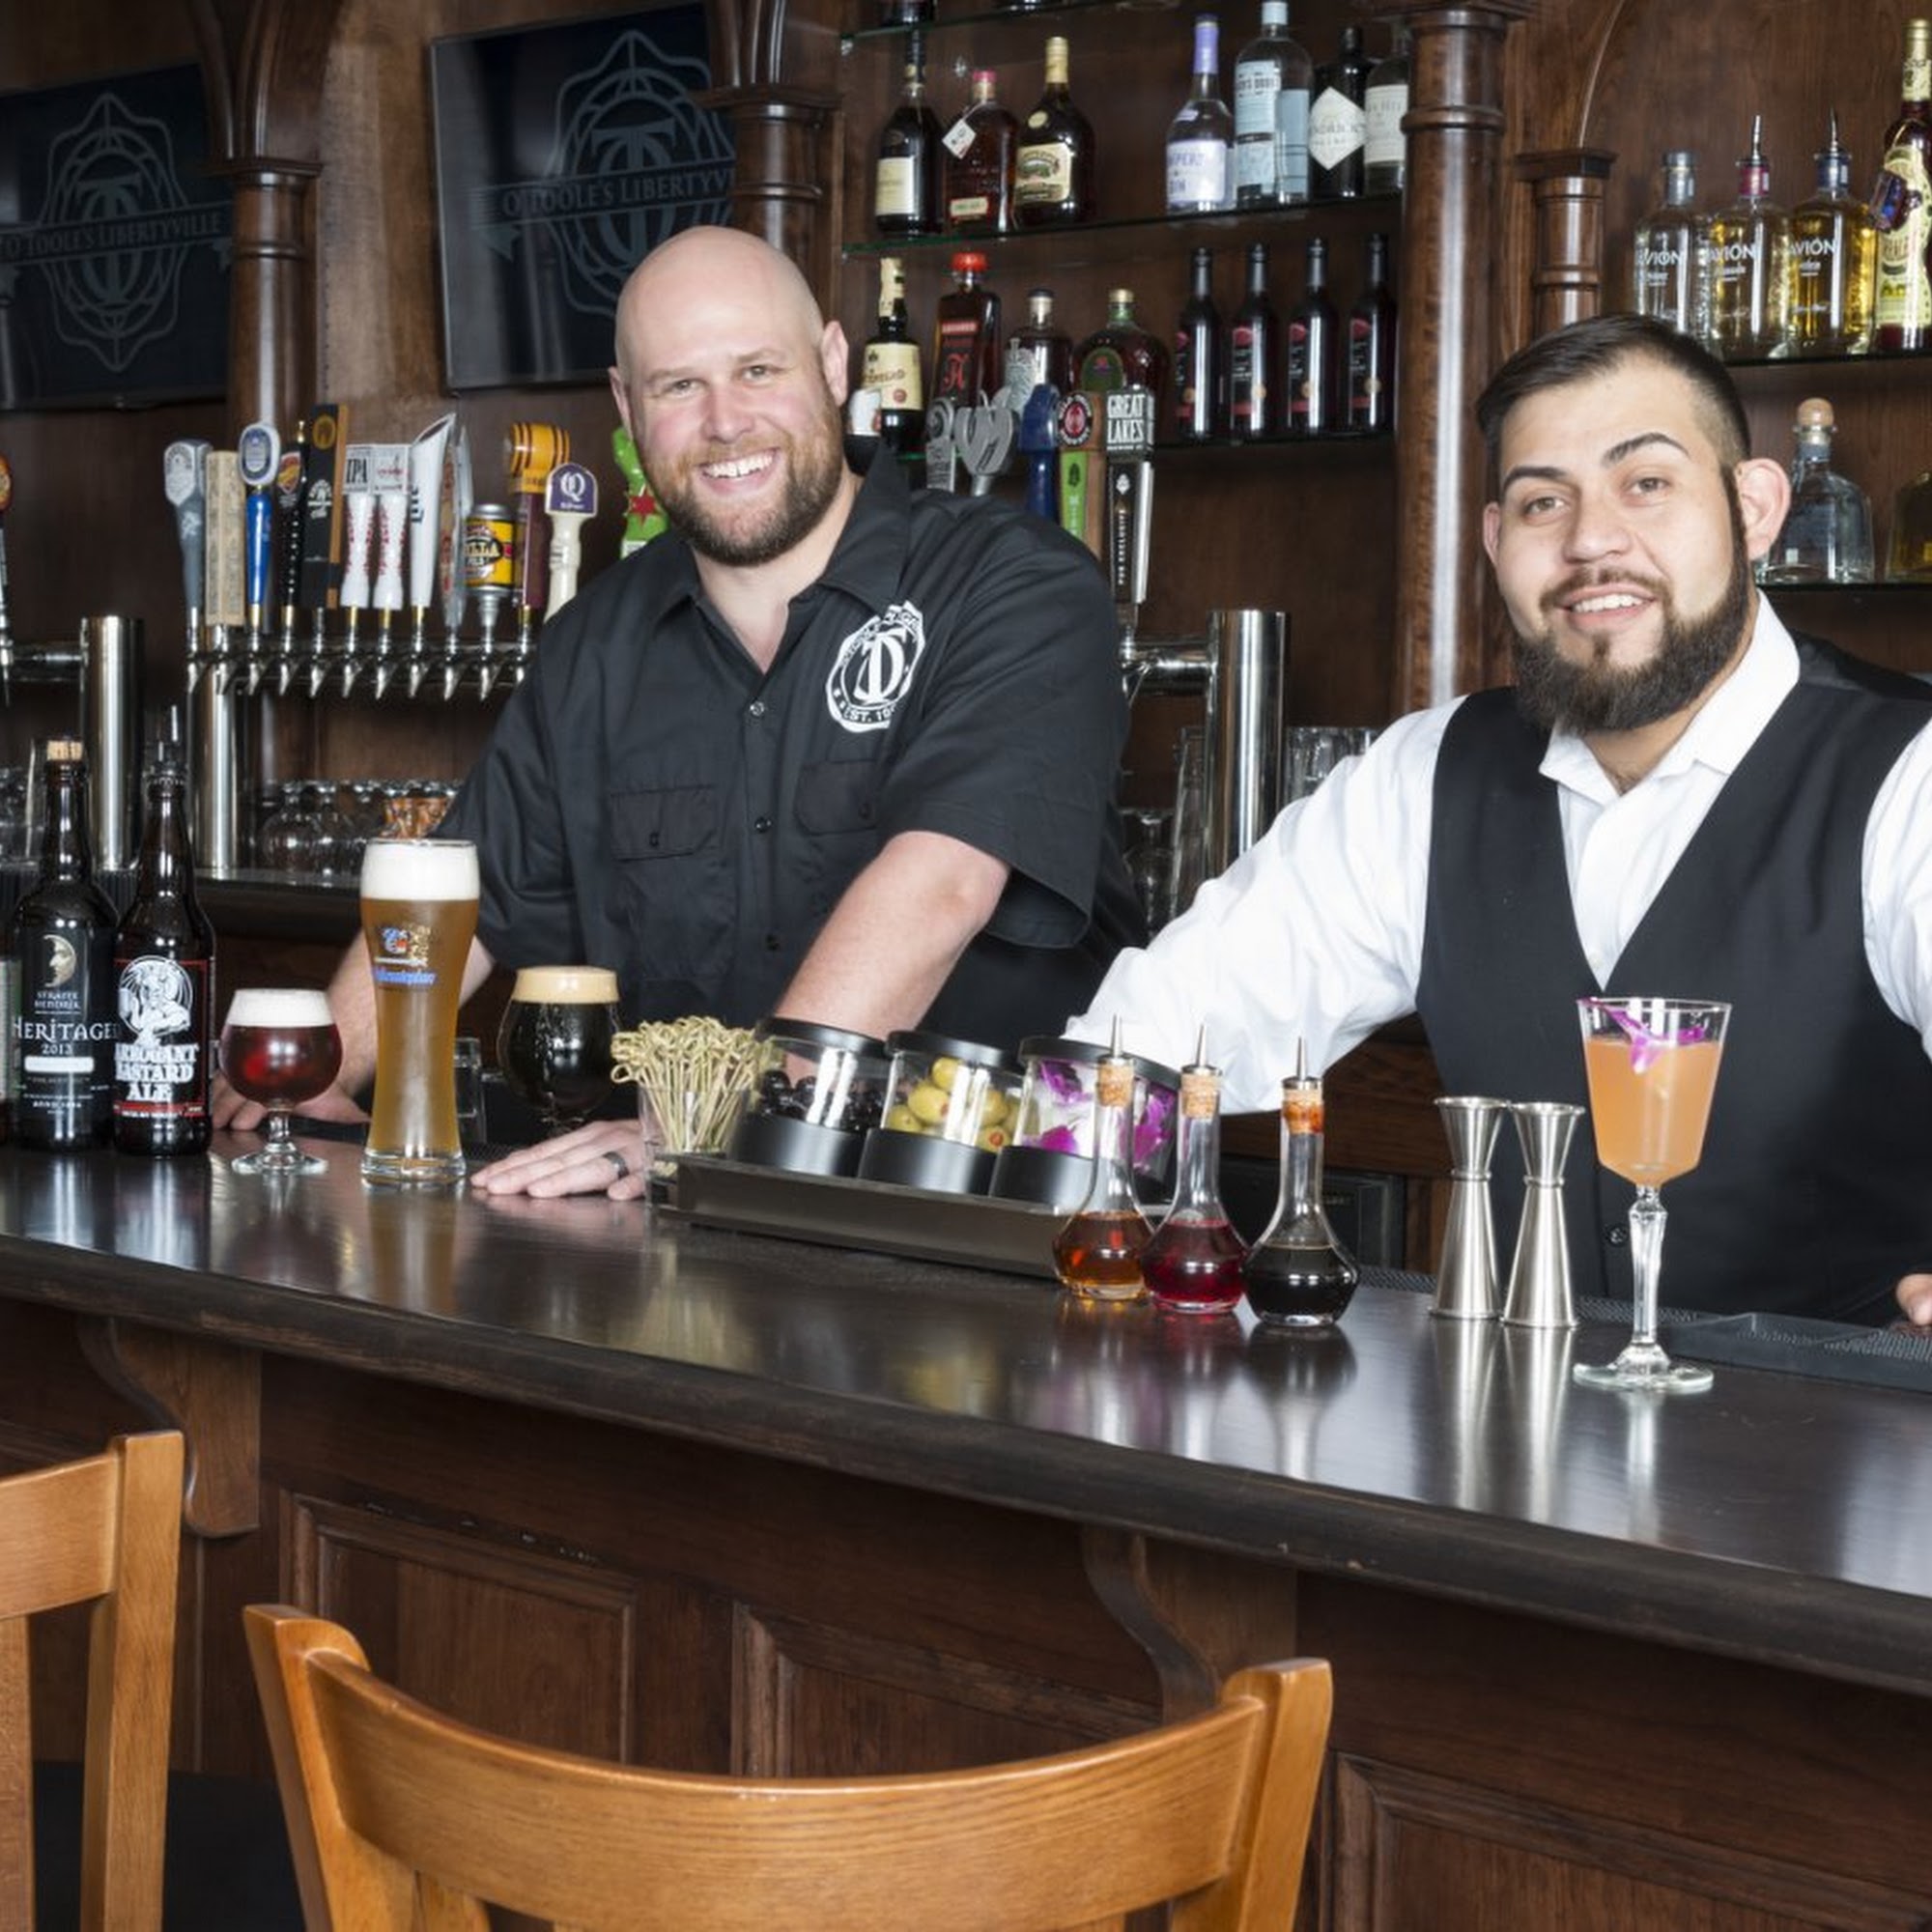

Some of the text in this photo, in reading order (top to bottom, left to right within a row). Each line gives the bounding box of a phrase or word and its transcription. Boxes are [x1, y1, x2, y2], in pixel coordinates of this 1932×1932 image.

[99, 213, 221, 248] LIBERTYVILLE
[1107, 393, 1146, 418] GREAT
[1107, 419, 1145, 444] LAKES
[346, 458, 368, 484] IPA
[126, 1082, 173, 1101] ALE
